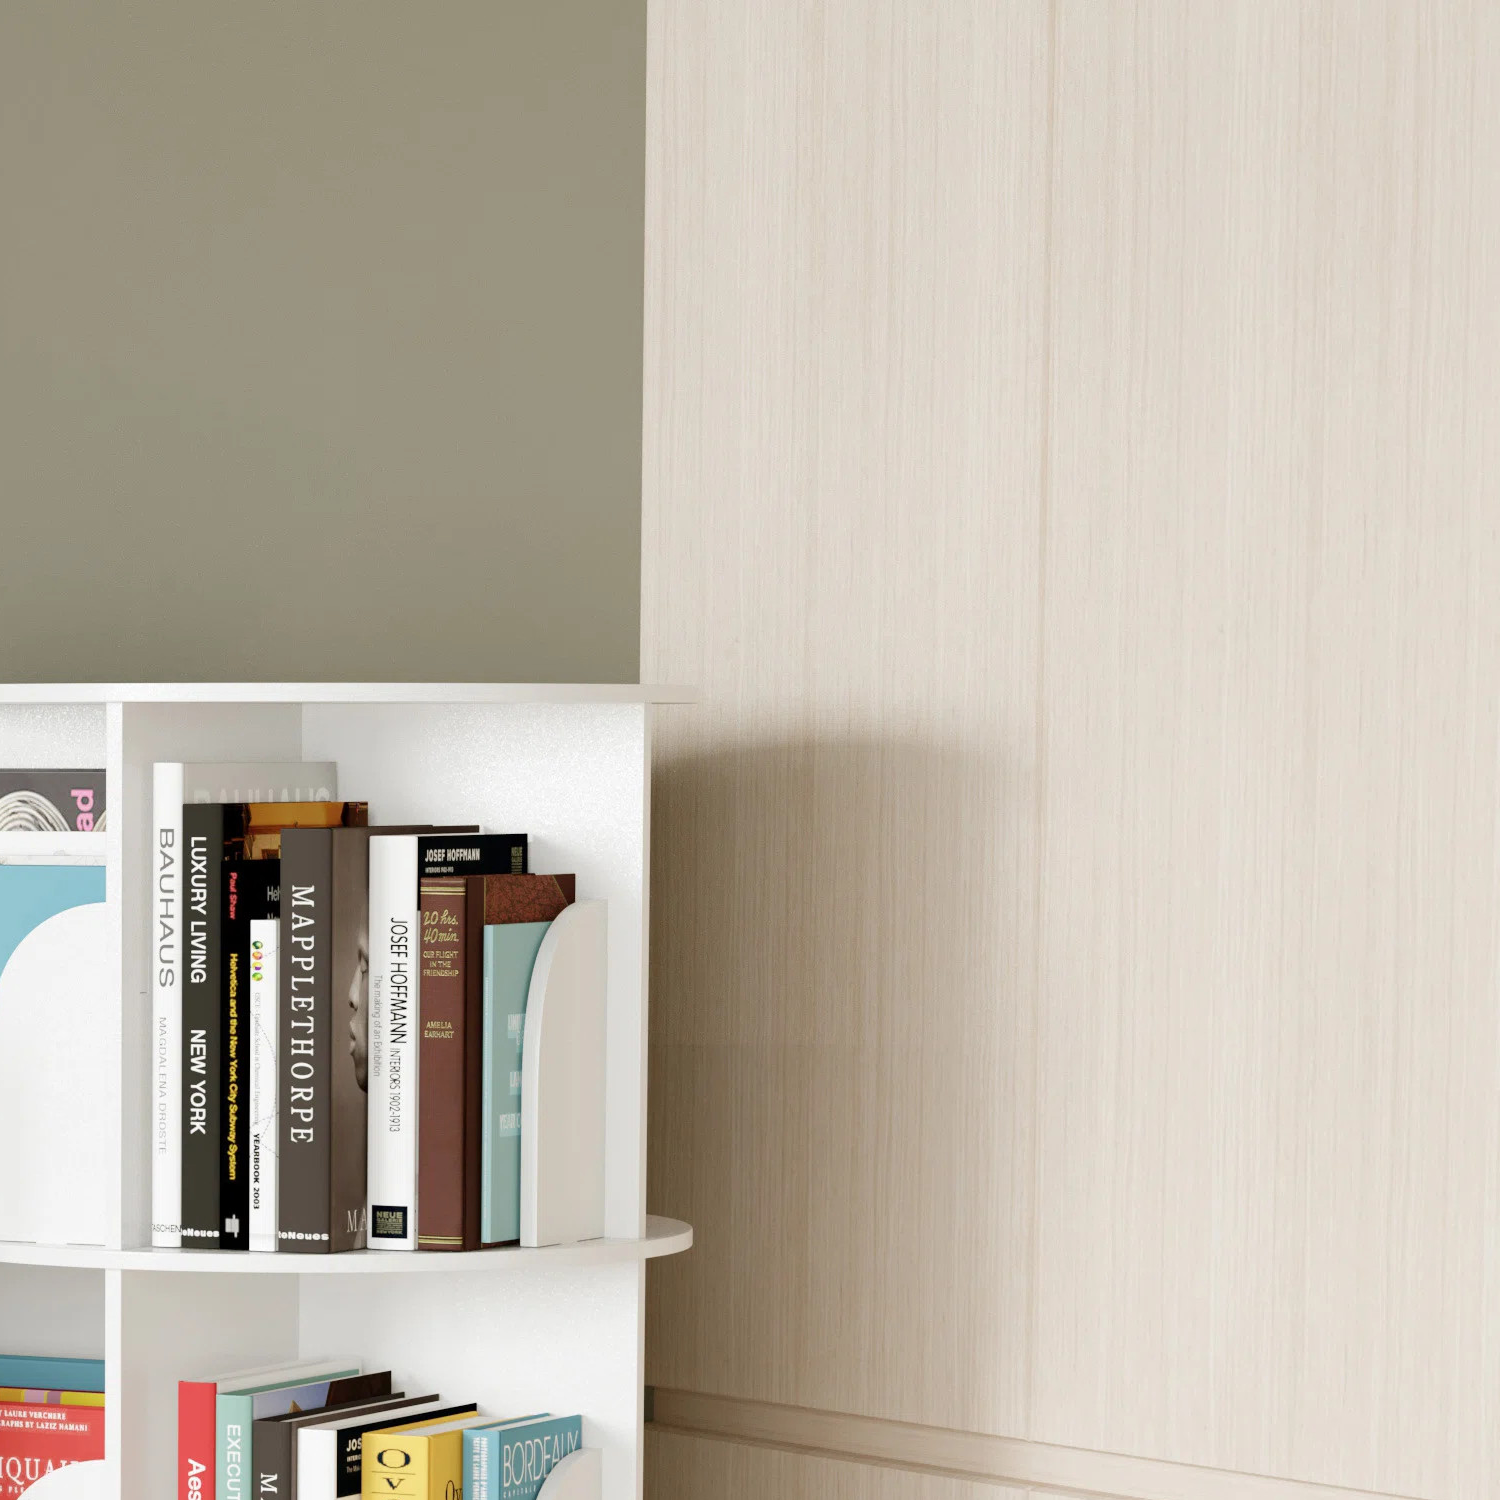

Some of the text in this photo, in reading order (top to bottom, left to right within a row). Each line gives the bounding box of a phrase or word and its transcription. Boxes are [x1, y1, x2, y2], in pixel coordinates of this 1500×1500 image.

[425, 849, 480, 862] JOSEF HOFFMANN
[159, 829, 174, 987] BAUHAUS
[191, 837, 206, 983] LUXURY LIVING
[436, 951, 458, 959] FLIGHT
[230, 954, 238, 997] Helvetica
[291, 885, 314, 1142] MAPPLETHORPE
[390, 918, 407, 1132] JOSEF HOFFMANN INTERIORS 1902-1913
[425, 1021, 454, 1032] AMELIA
[424, 1030, 454, 1038] EARHART
[190, 1030, 206, 1134] NEW YORK
[228, 1084, 238, 1102] City
[227, 1104, 238, 1142] Subway
[227, 1145, 238, 1180] System
